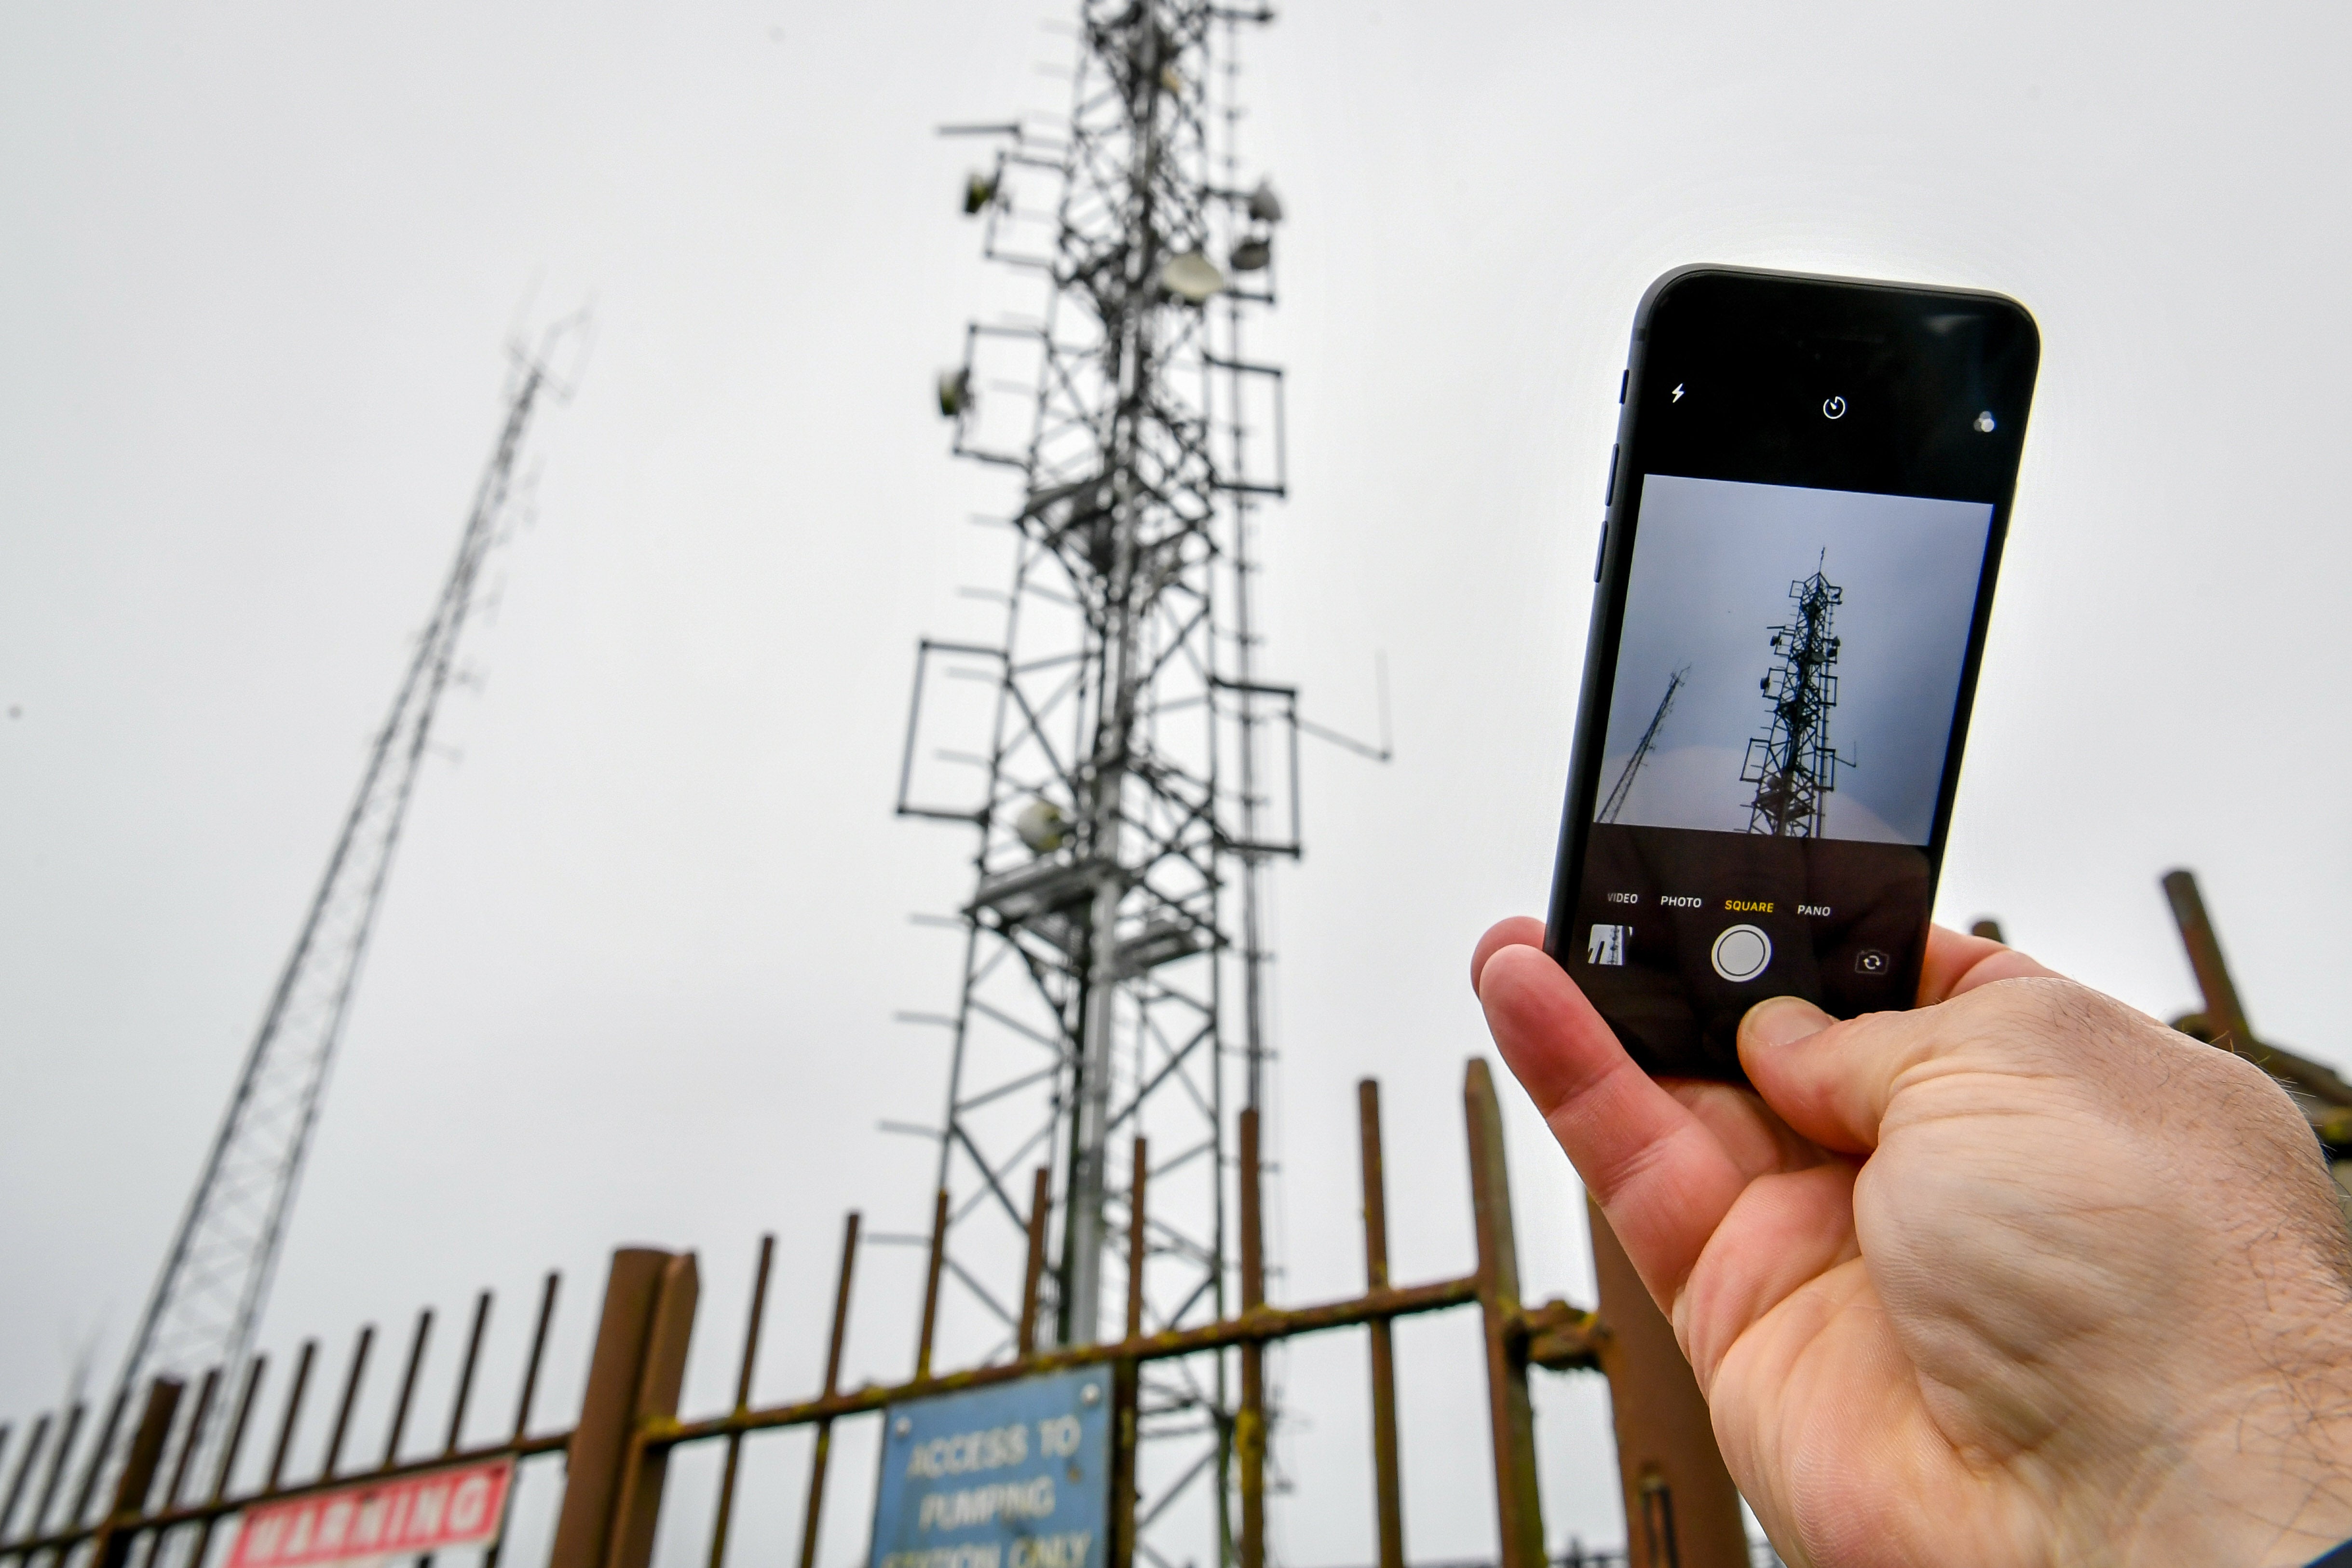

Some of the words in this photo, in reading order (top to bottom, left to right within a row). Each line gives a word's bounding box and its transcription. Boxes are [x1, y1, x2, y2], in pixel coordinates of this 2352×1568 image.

[1607, 893, 1638, 903] VIDEO
[1660, 896, 1702, 908] PHOTO
[1725, 900, 1774, 913] SQUARE
[1797, 905, 1831, 916] PANO
[907, 1424, 1028, 1479] ACCESS
[1039, 1415, 1082, 1458] TO
[244, 1477, 489, 1561] WARNING
[919, 1476, 1056, 1532] PUMPING
